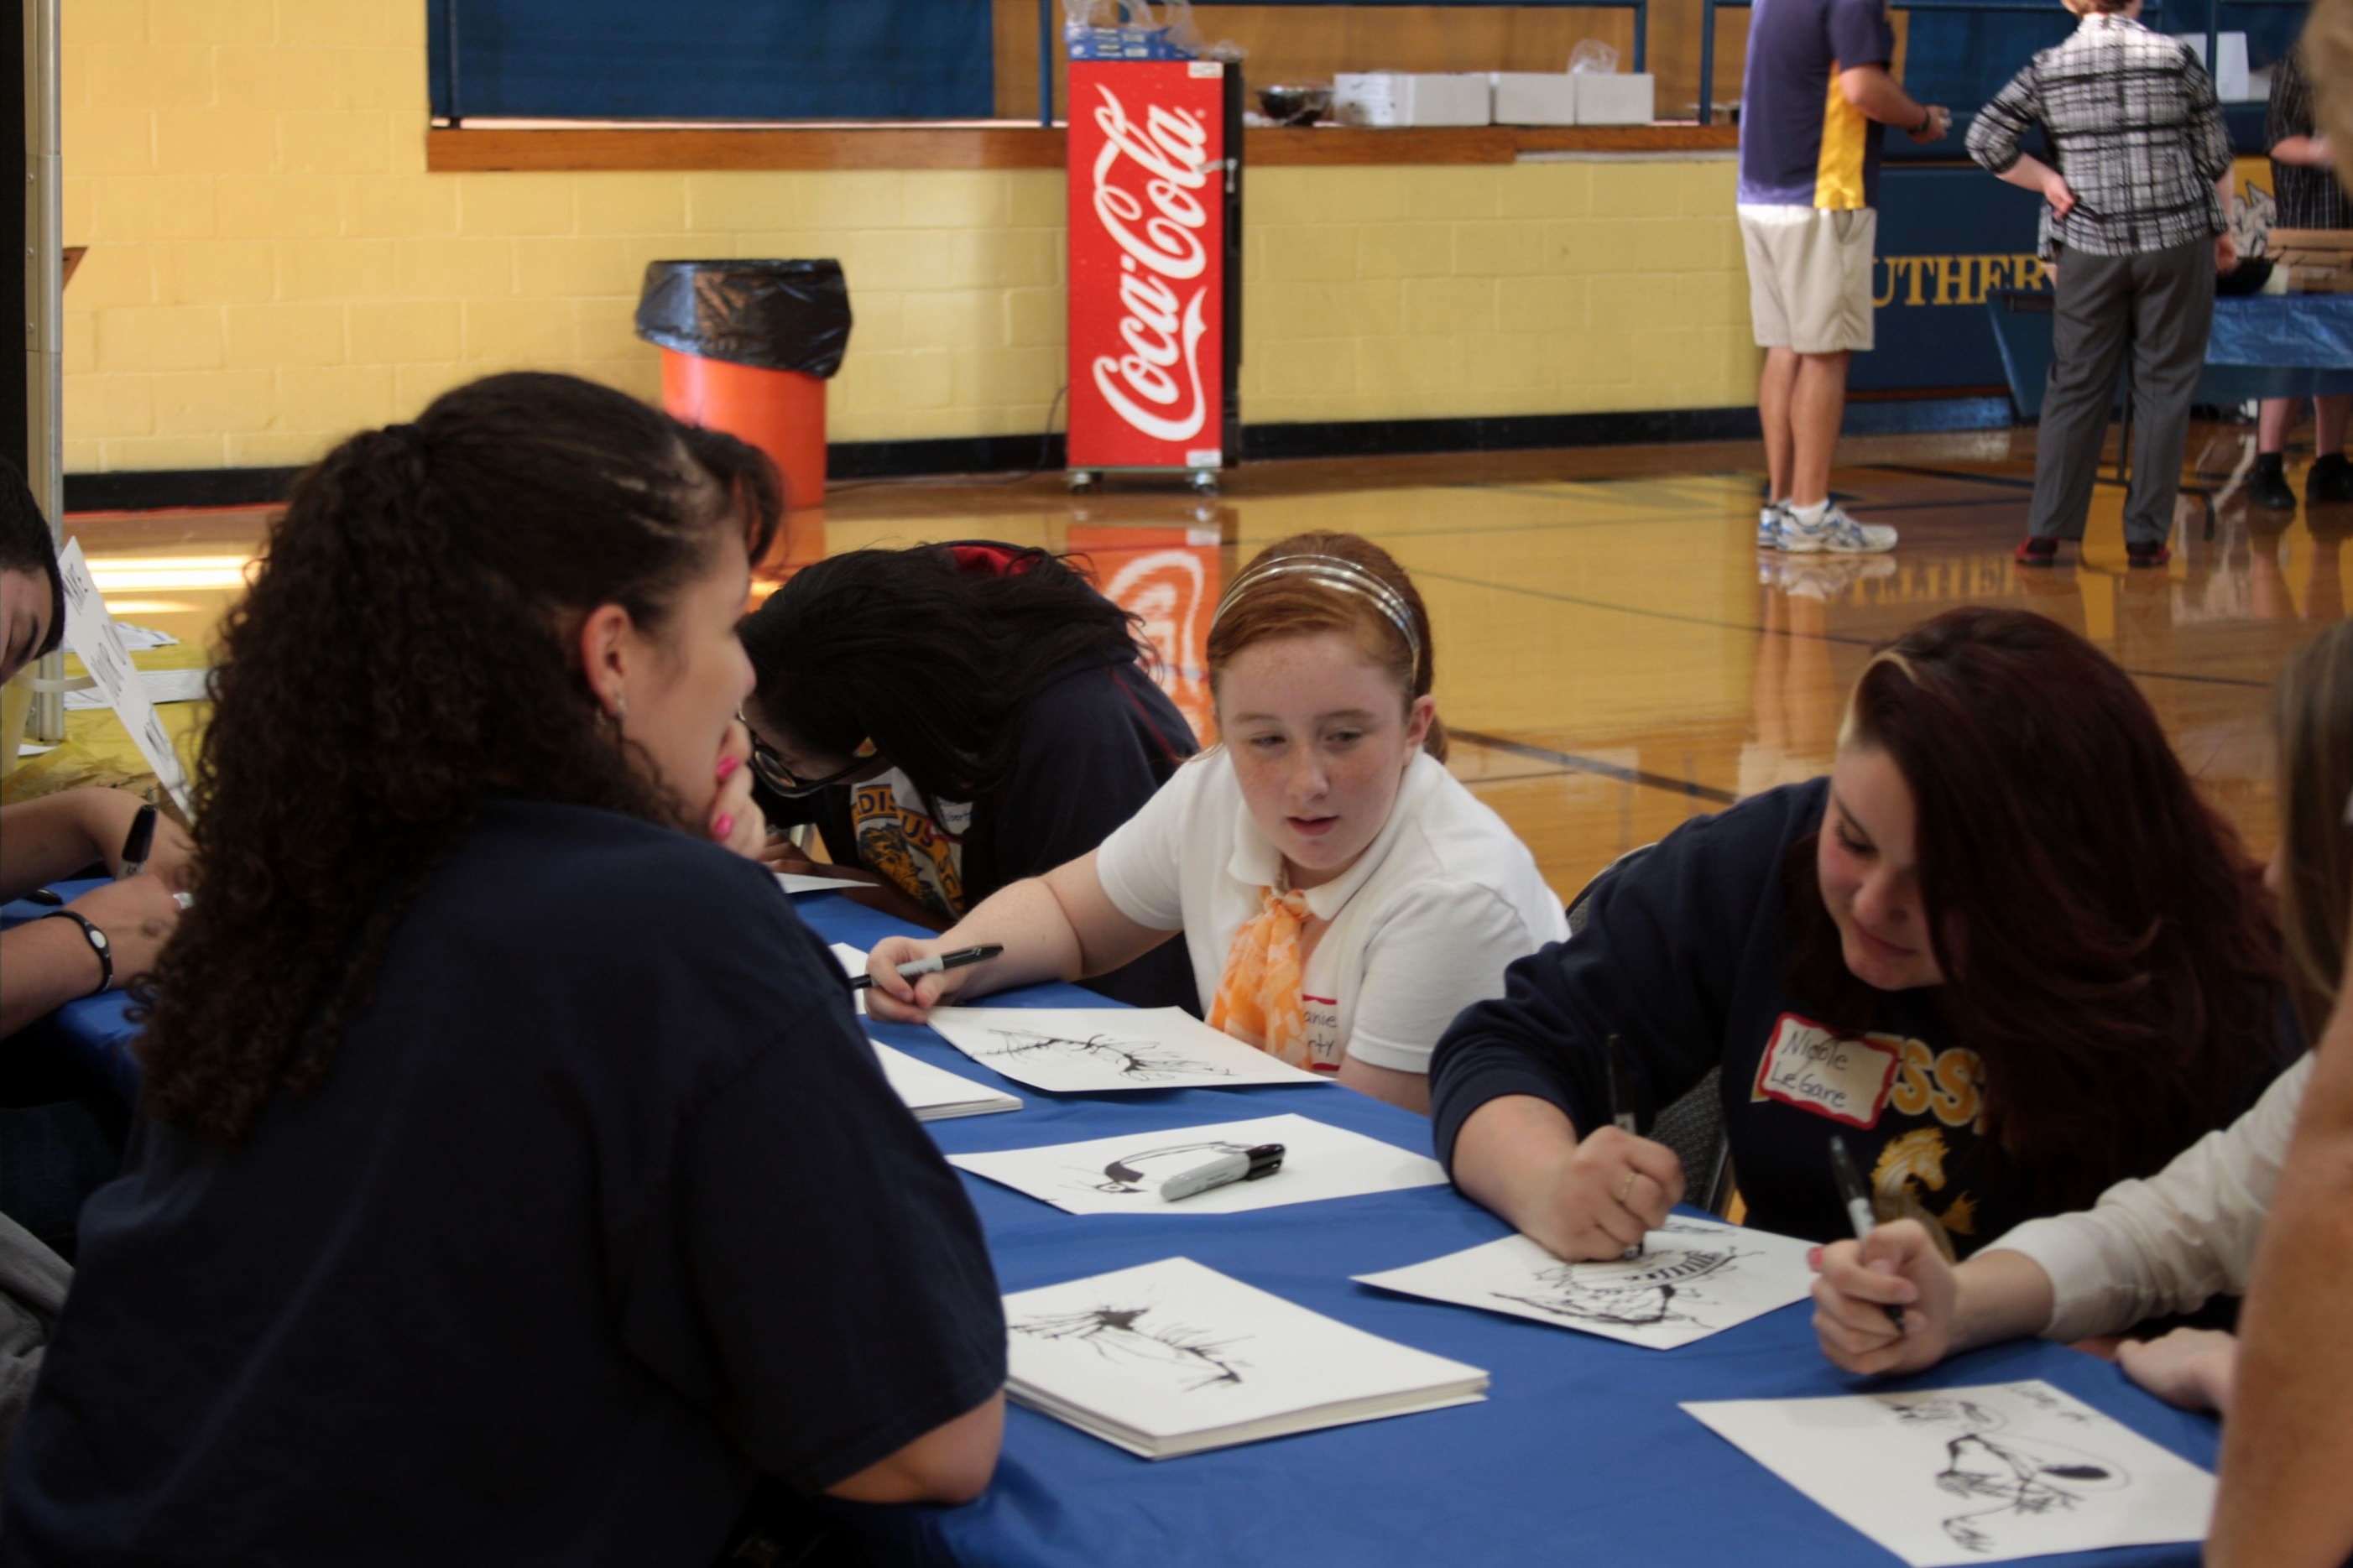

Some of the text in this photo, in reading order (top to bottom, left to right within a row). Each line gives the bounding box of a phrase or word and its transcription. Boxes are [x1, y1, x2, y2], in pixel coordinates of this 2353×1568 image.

[1093, 82, 1208, 441] Coca-Cola
[1782, 1030, 1850, 1071] Nicole
[1888, 1036, 1984, 1128] SS
